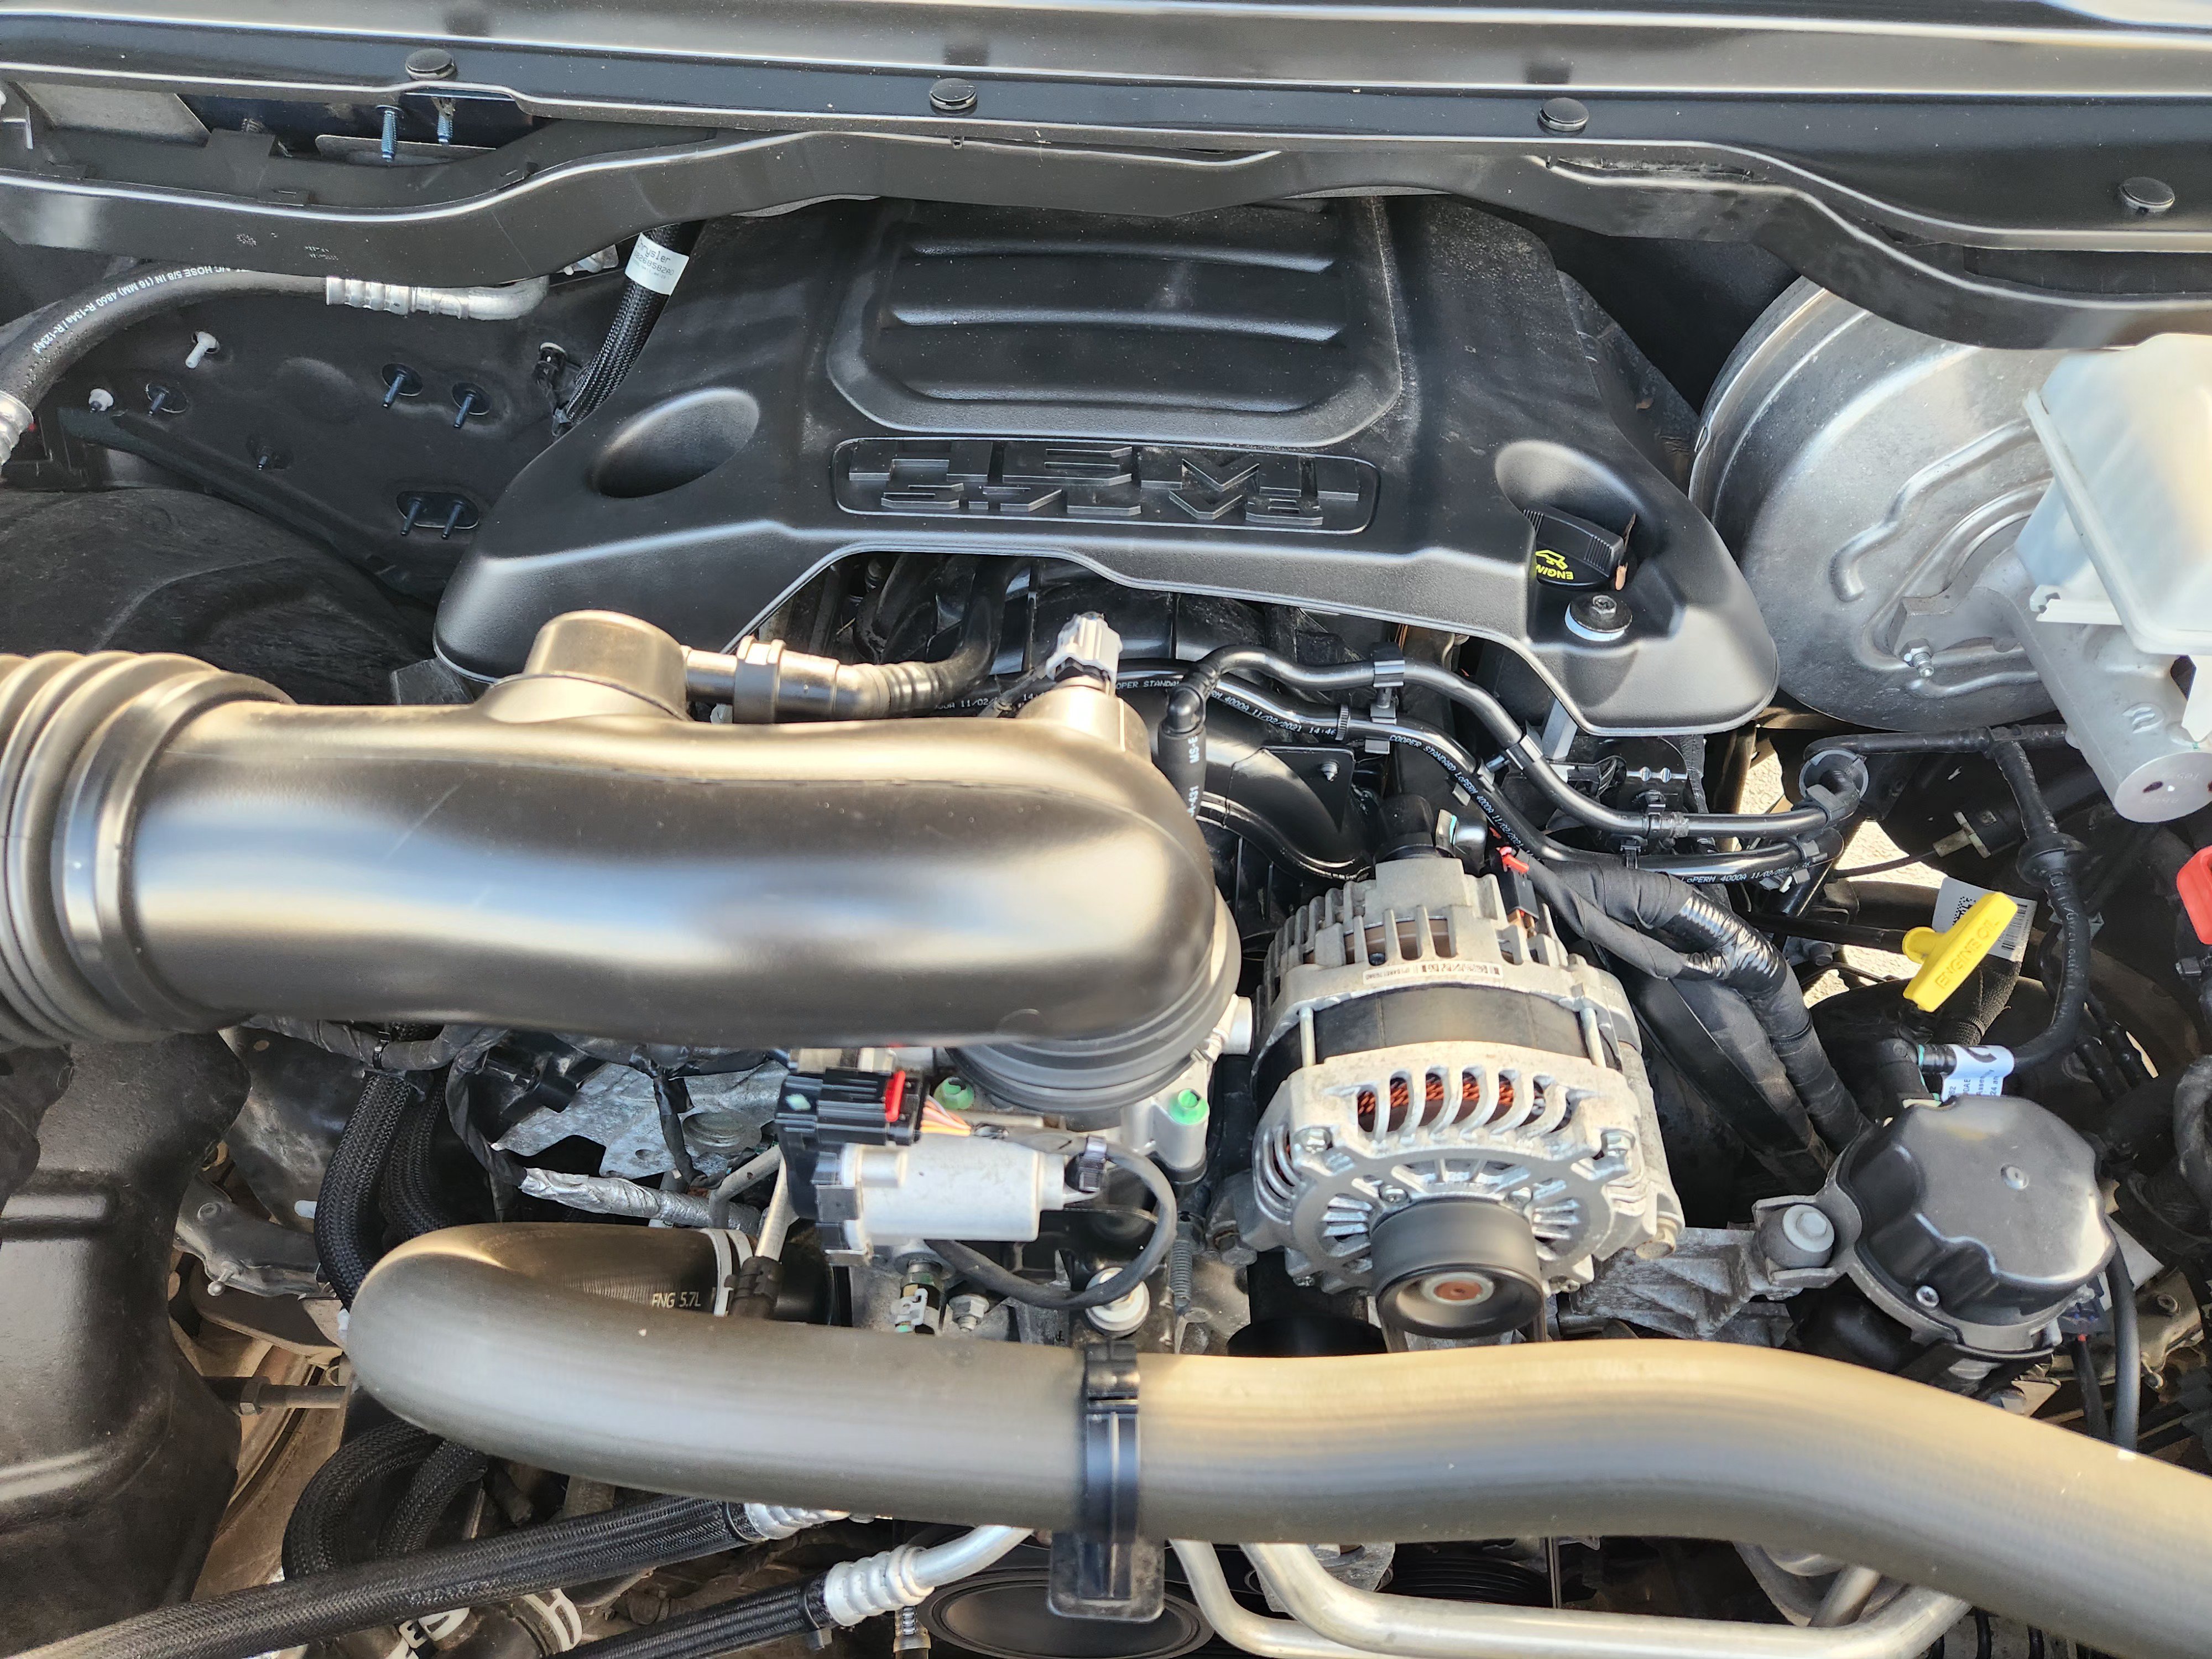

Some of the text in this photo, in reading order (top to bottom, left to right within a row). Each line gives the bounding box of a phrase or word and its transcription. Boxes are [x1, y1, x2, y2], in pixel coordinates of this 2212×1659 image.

[155, 274, 166, 284] IN
[167, 272, 182, 281] 5/8
[182, 265, 213, 278] HOSE
[117, 282, 139, 296] MM)
[139, 276, 154, 289] (16
[96, 291, 117, 307] 4860
[65, 302, 97, 324] R-134a
[849, 441, 1359, 502] HEMI
[1168, 487, 1323, 526] V8
[1535, 564, 1574, 580] ENGIN
[1116, 681, 1139, 690] OPER
[961, 697, 997, 708] 11/02/
[1225, 696, 1250, 712] 4000A
[1252, 708, 1302, 732] 11/02/2021
[1389, 734, 1422, 748] COOPER
[1423, 745, 1457, 772] STANDARD
[1491, 814, 1524, 847] 11/02/2021
[1187, 785, 1199, 817] A-431
[1719, 874, 1747, 883] 4000A
[1936, 919, 2000, 989] ENGINE OIL
[679, 1291, 701, 1307] 5.7L
